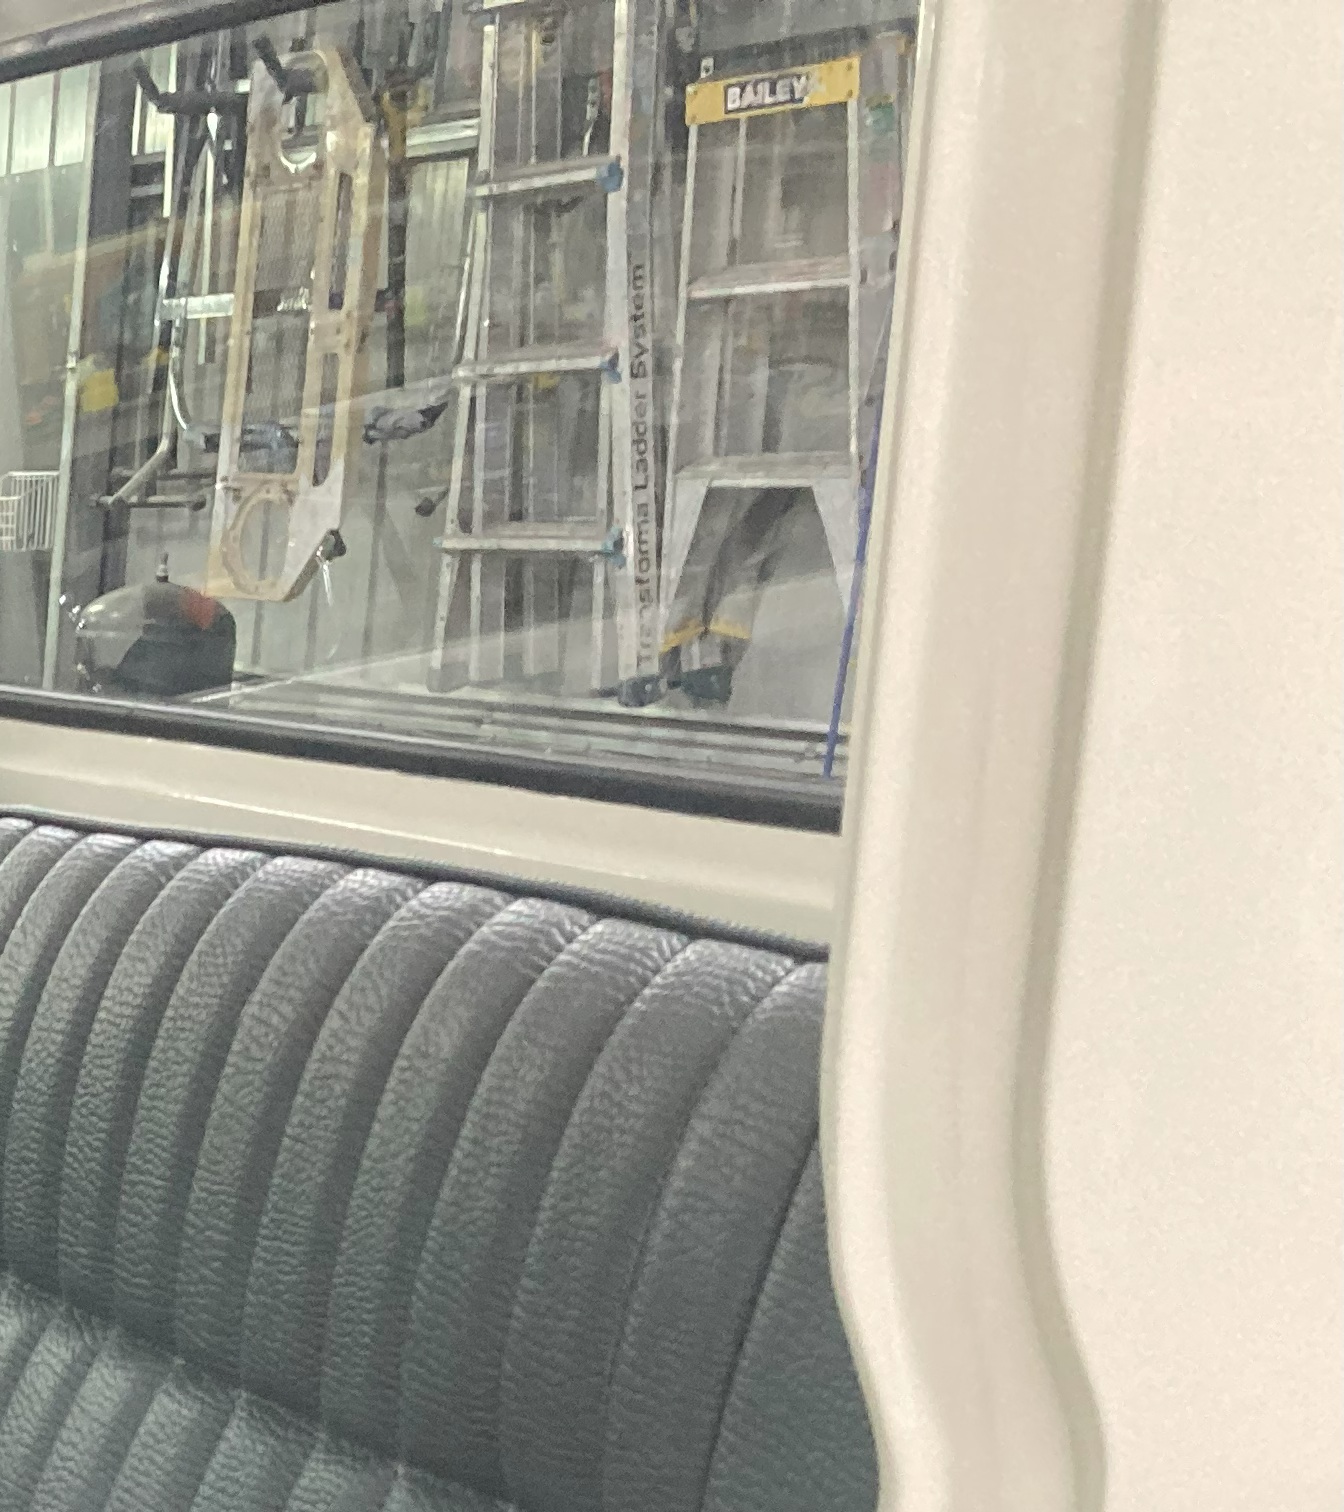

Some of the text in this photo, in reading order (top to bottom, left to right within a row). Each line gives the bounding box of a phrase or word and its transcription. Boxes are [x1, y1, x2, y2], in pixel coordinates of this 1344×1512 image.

[727, 75, 810, 112] BAILEY
[629, 264, 650, 379] System
[631, 391, 649, 490] Ladder
